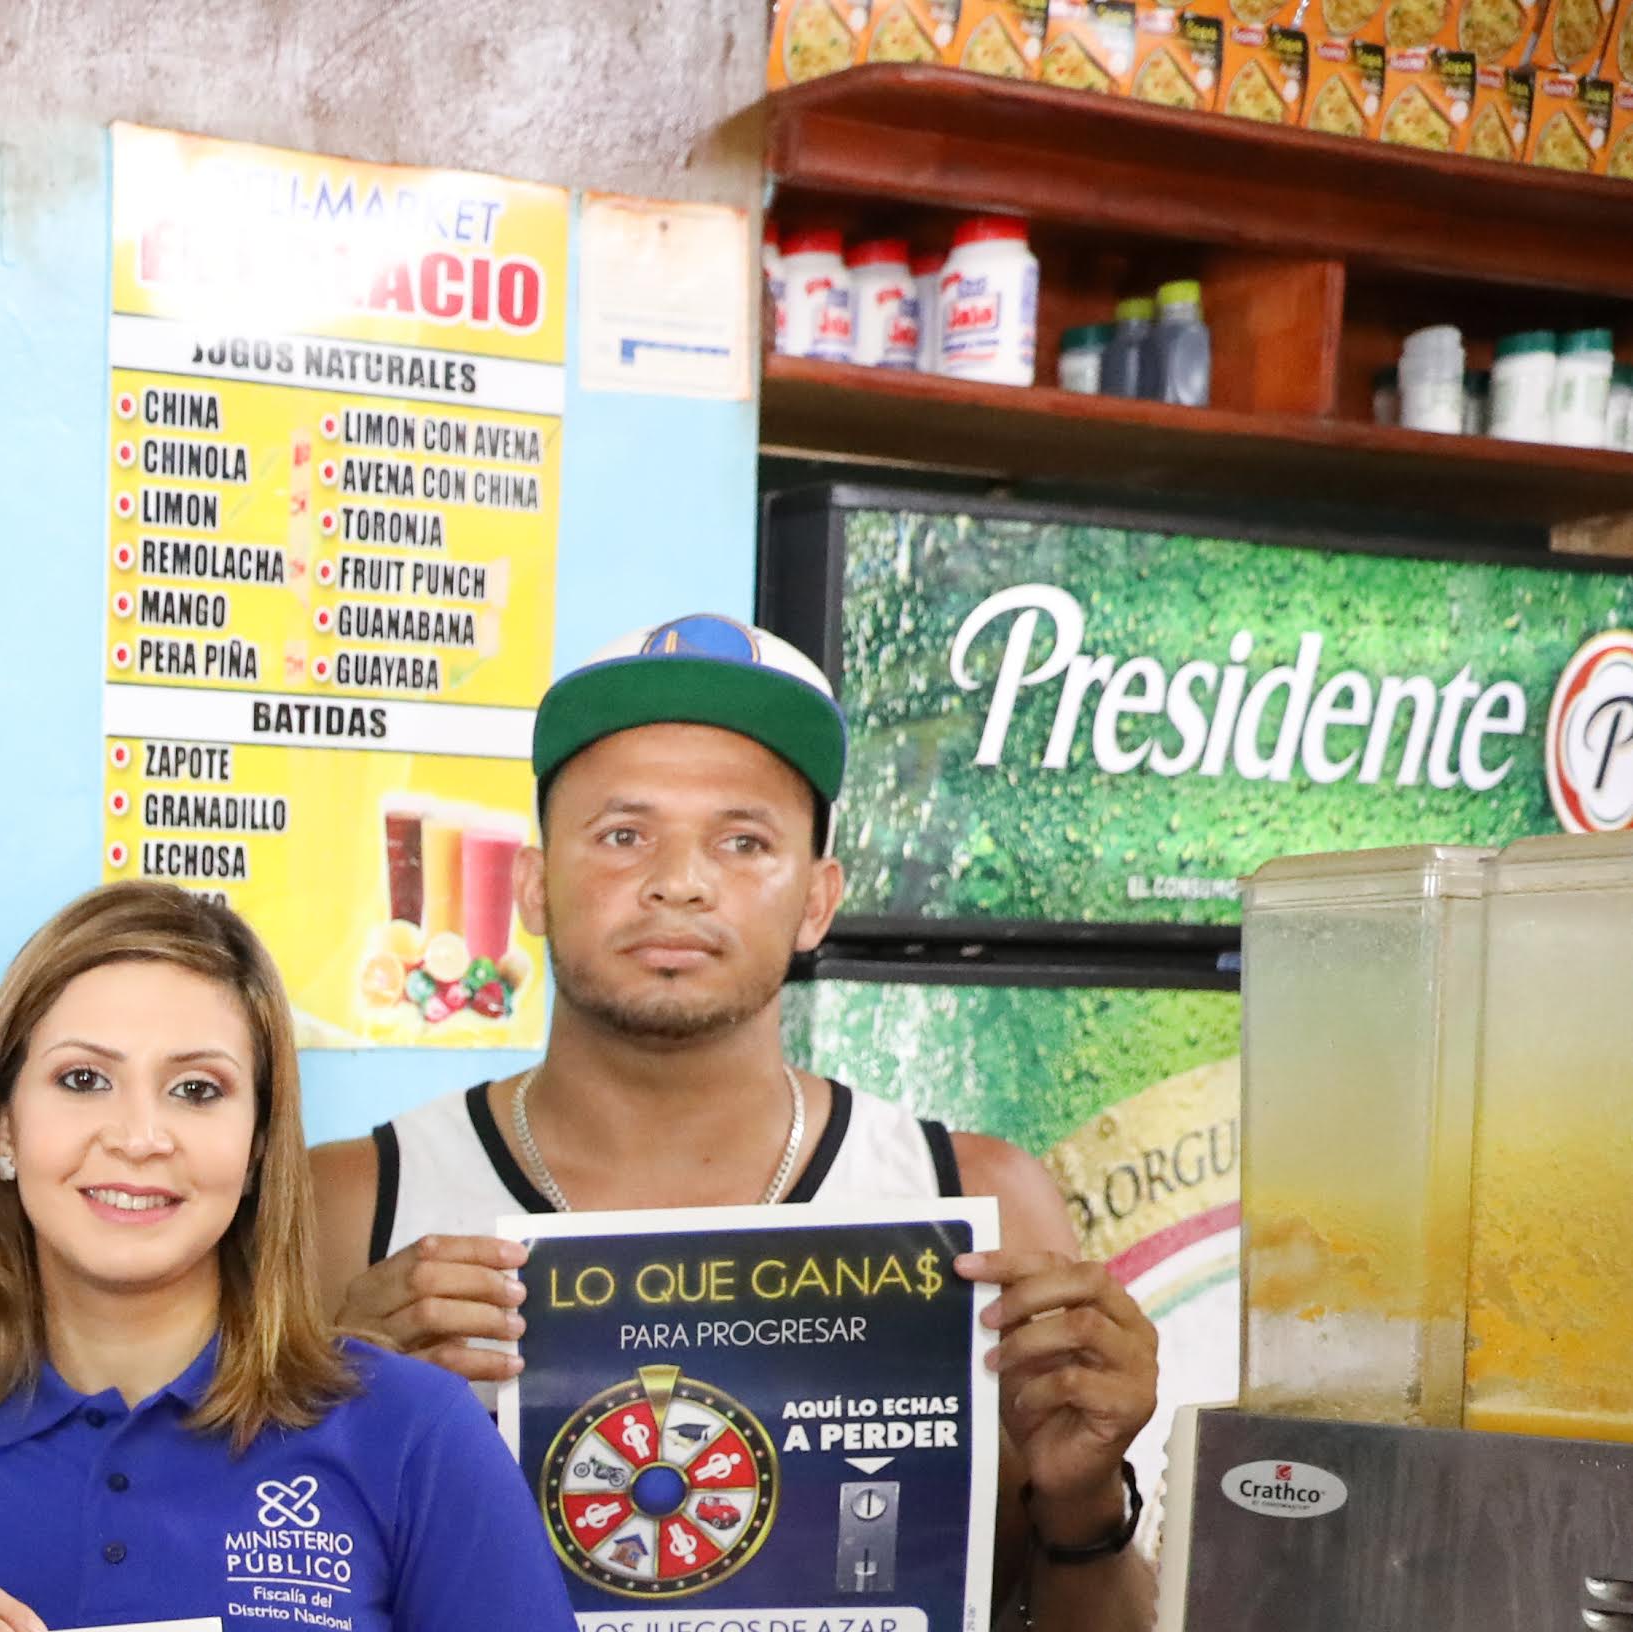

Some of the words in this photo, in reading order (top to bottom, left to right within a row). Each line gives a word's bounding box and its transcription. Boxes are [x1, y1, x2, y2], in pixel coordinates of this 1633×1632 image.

[305, 345, 477, 393] NATURALES
[145, 389, 219, 429] CHINA
[345, 411, 415, 449] LIMON
[424, 419, 466, 455] CON
[475, 424, 540, 462] AVENA
[144, 440, 247, 482] CHINOLA
[343, 460, 414, 496] AVENA
[423, 466, 466, 502] CON
[474, 472, 538, 509] CHINA
[143, 490, 217, 528] LIMON
[342, 508, 442, 547] TORONJA
[142, 540, 284, 584] REMOLACHA
[341, 556, 404, 592] FRUIT
[413, 562, 485, 598] PUNCH
[141, 590, 225, 627] MANGO
[339, 605, 474, 646] GUANABANA
[139, 639, 196, 675] PERA
[205, 639, 257, 679] PIÑA
[337, 653, 439, 690] GUAYABA
[950, 582, 1526, 791] Presidente
[253, 702, 387, 738] BATIDAS
[145, 745, 229, 780] ZAPOTE
[145, 794, 286, 831] GRANADILLO
[143, 843, 246, 878] LECHOSA
[549, 1265, 615, 1308] LO
[635, 1260, 734, 1304] QUE
[751, 1248, 943, 1301] GANA$
[619, 1323, 692, 1350] PARA
[697, 1316, 867, 1348] PROGRESAR
[781, 1424, 810, 1451] A
[819, 1420, 958, 1450] PERDER
[1240, 1480, 1320, 1503] Crathco
[225, 1530, 353, 1556] MINISTERIO
[227, 1549, 351, 1583] PÚBLICO
[253, 1586, 306, 1606] Fiscalía
[311, 1590, 333, 1608] del
[228, 1602, 290, 1621] Distrito
[294, 1608, 353, 1632] Nacional
